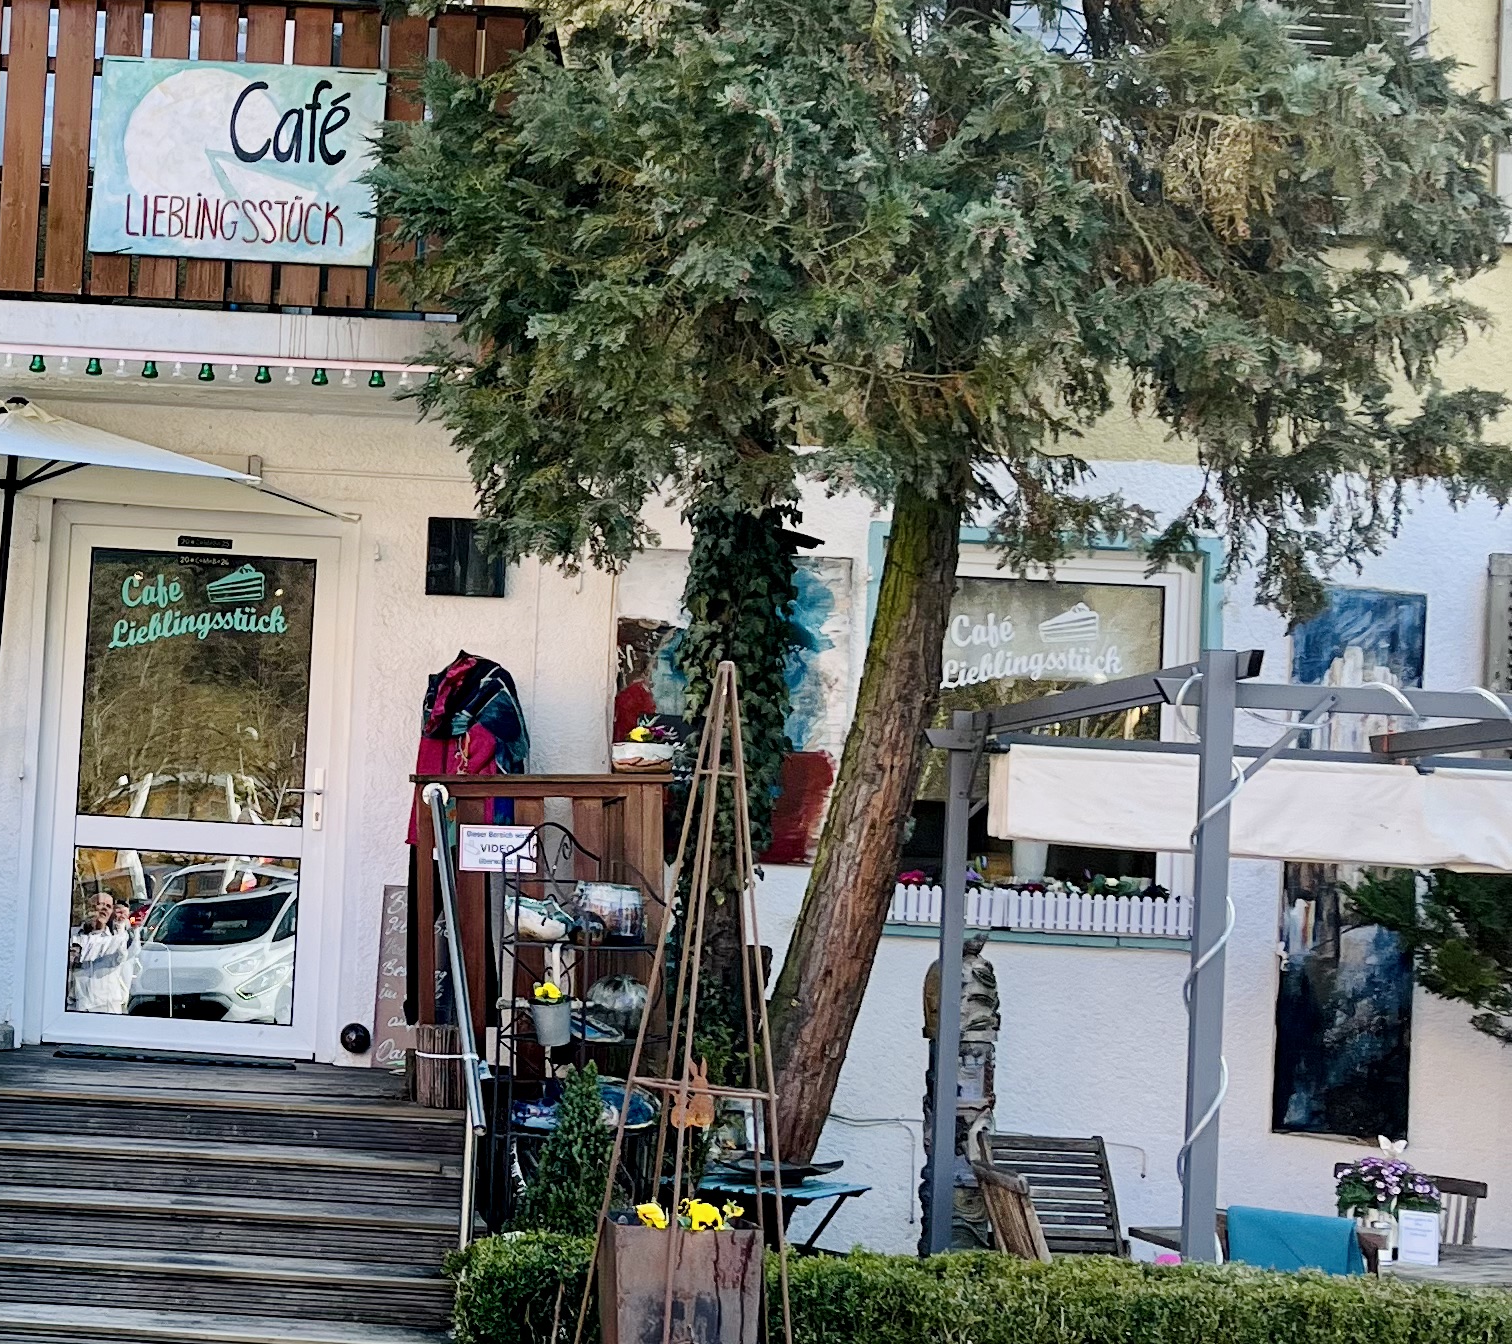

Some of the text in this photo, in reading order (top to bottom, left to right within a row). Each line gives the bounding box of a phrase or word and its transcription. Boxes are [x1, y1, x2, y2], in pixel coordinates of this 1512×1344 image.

[230, 80, 351, 165] Café
[121, 574, 185, 608] Café
[108, 605, 288, 649] Lieblingsstück
[950, 613, 1015, 648] Café
[939, 646, 1123, 690] Lieblingsstück
[480, 844, 515, 853] VIDEO
